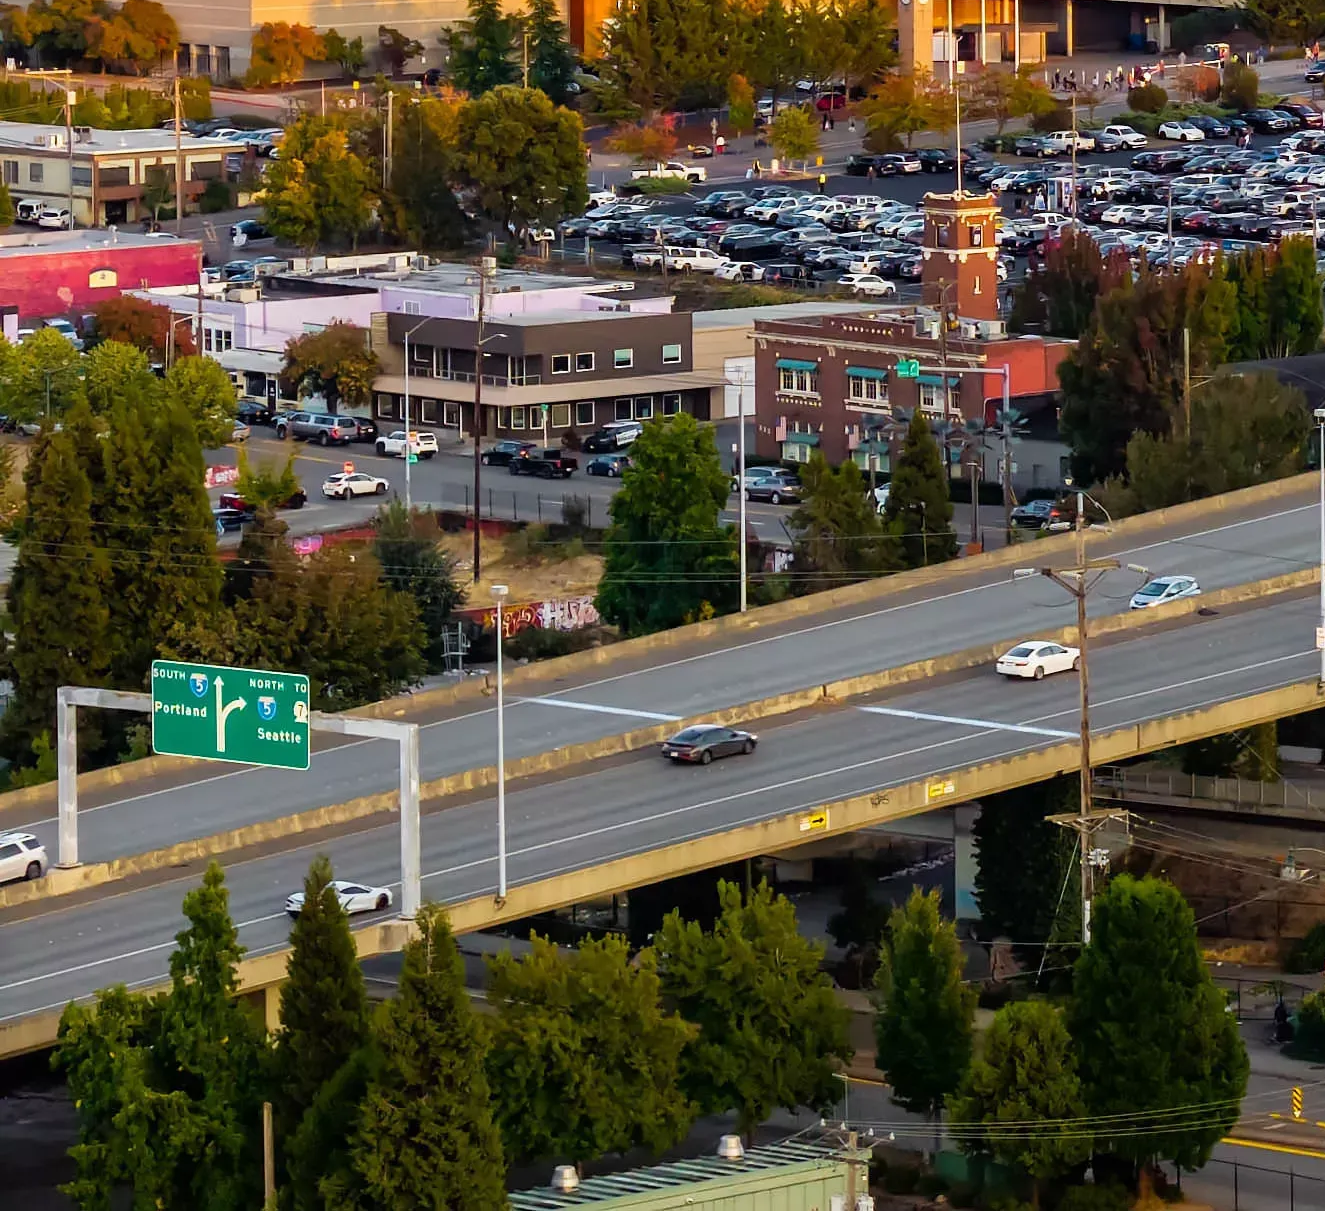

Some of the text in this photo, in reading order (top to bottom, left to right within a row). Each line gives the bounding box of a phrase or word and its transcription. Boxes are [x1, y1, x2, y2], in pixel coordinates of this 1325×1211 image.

[153, 667, 204, 693] SOUTH 5
[249, 677, 307, 694] NORTH TO
[154, 700, 208, 718] Portland
[263, 703, 271, 716] 5
[297, 703, 304, 717] 7
[257, 727, 302, 744] Seattle
